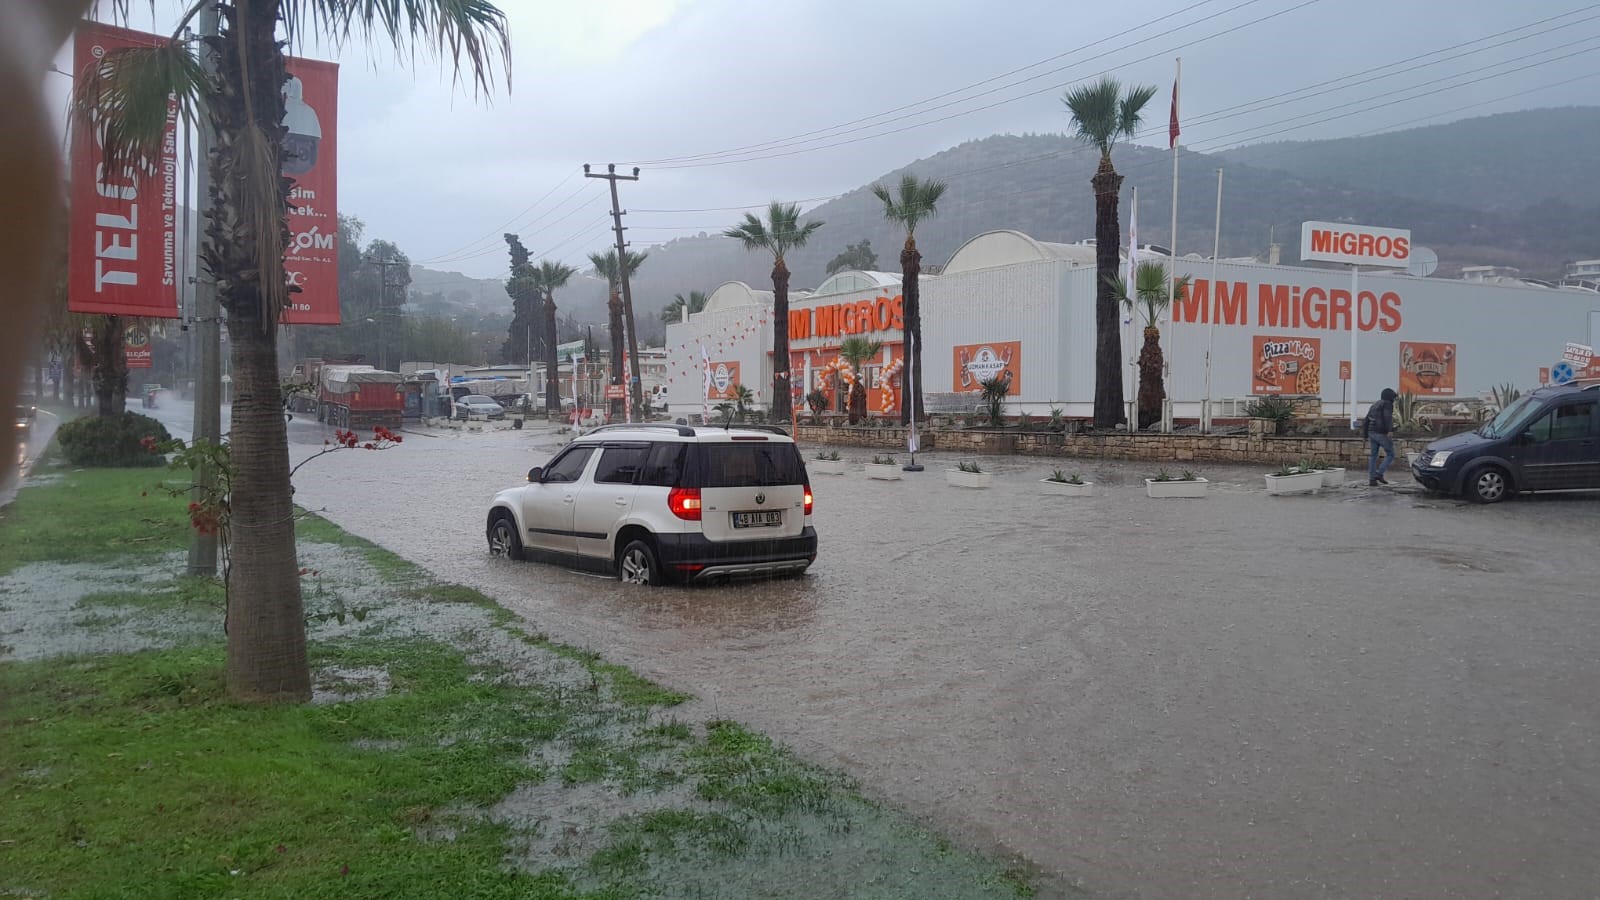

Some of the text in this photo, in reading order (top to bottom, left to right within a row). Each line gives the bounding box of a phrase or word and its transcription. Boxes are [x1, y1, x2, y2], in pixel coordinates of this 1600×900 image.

[164, 129, 175, 154] San.
[163, 157, 175, 211] Teknoloji
[289, 187, 315, 199] şim
[164, 214, 173, 227] ve
[163, 231, 173, 286] Savunma
[1173, 277, 1248, 325] MM
[739, 513, 748, 523] 48
